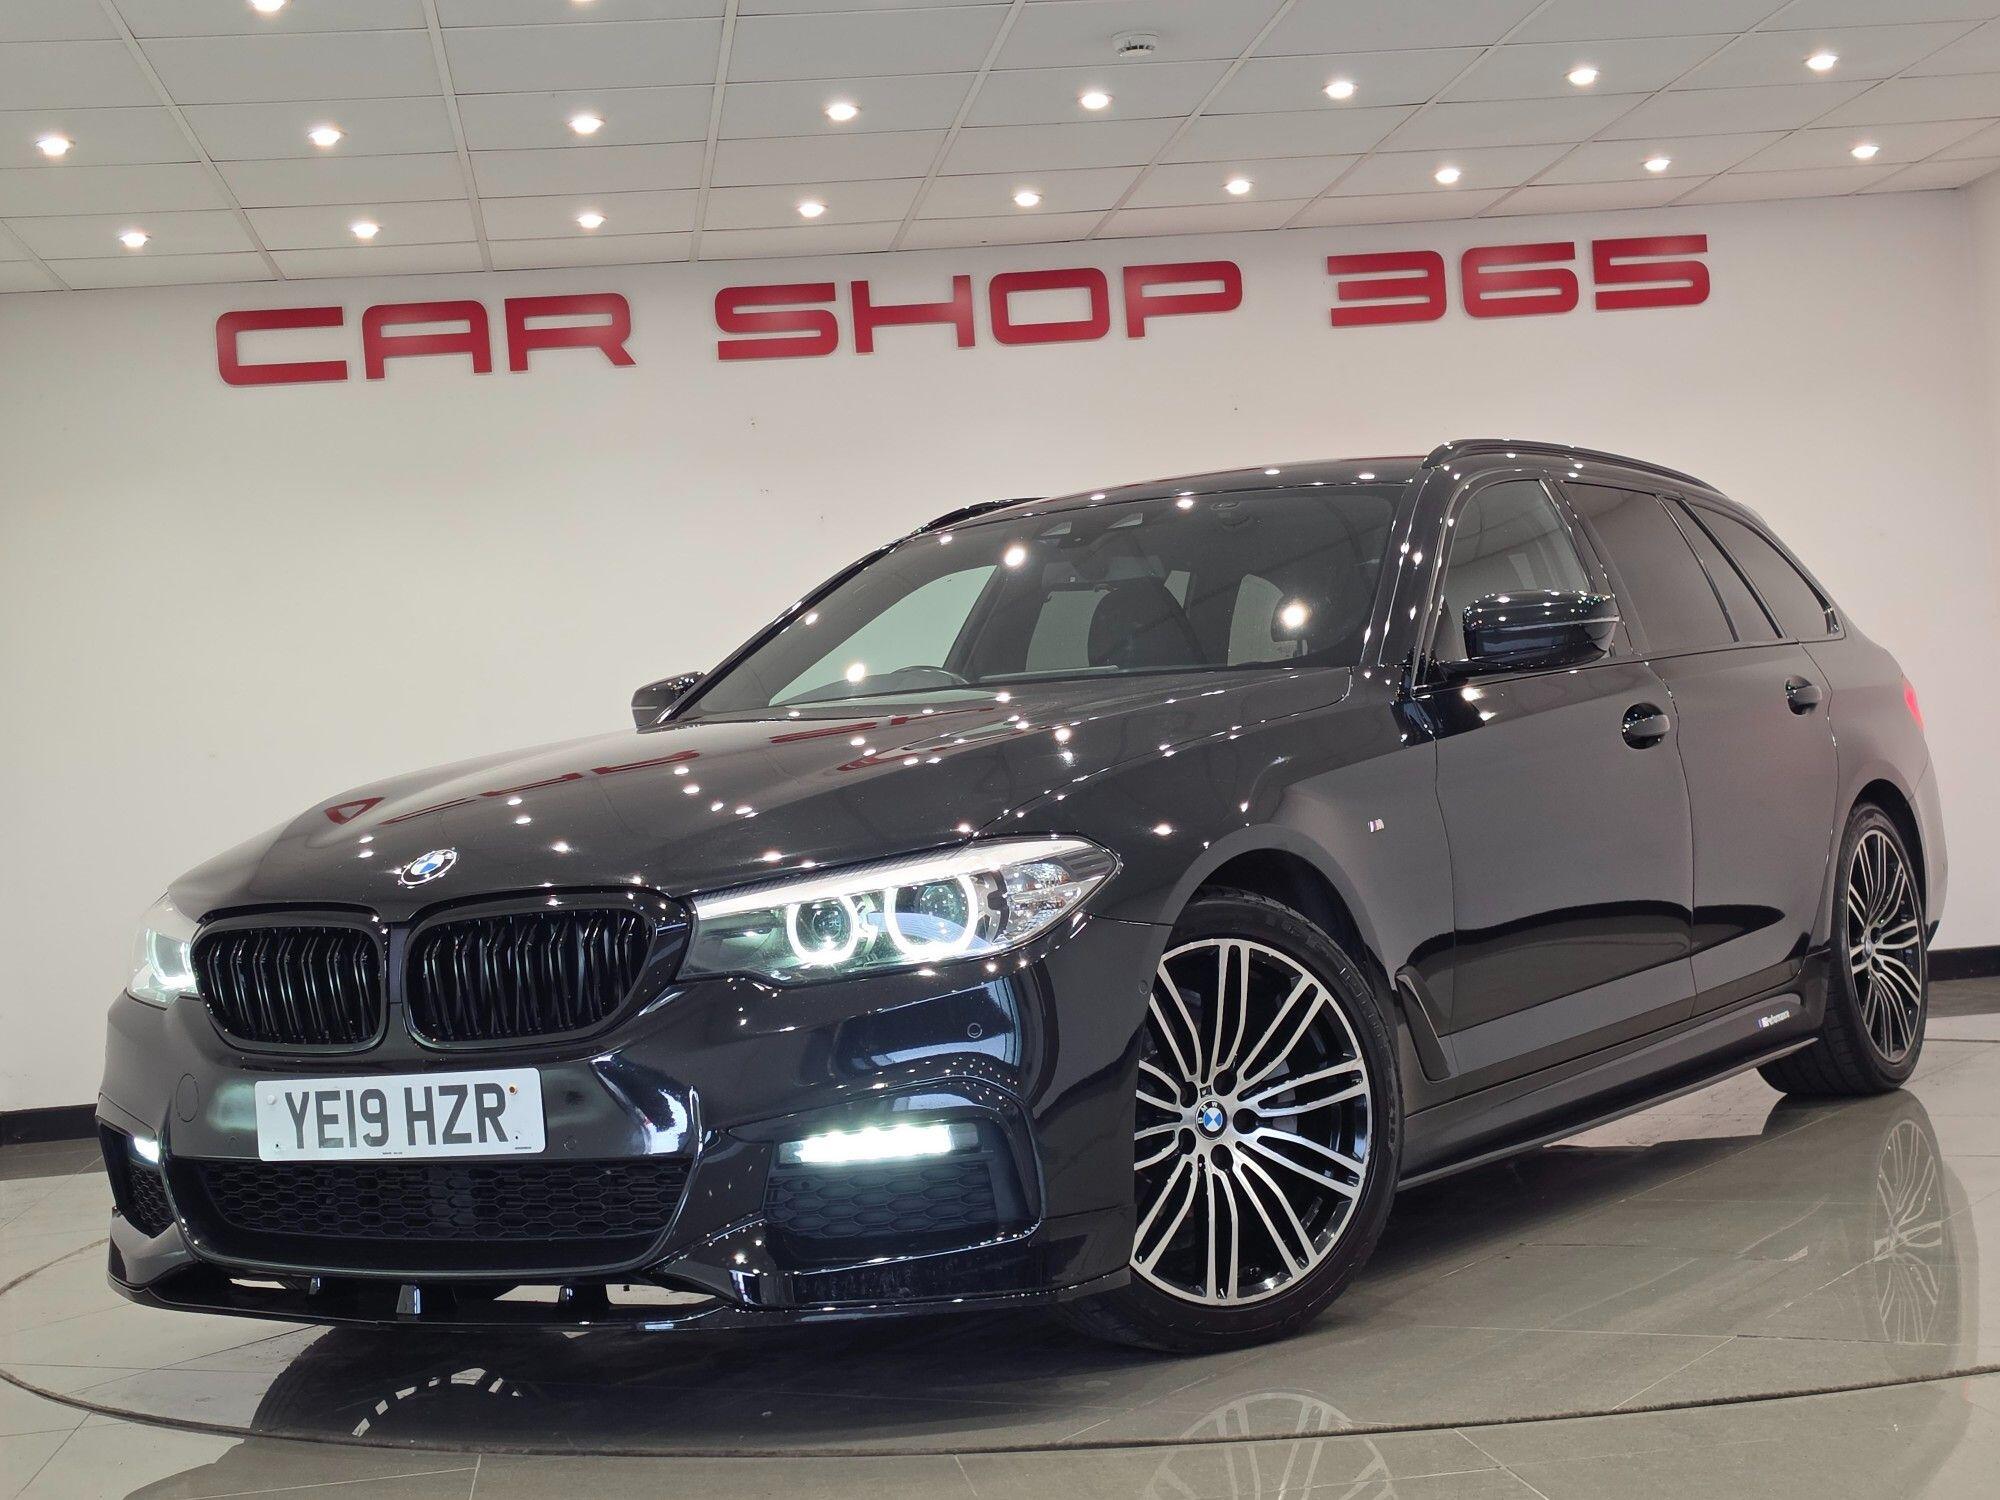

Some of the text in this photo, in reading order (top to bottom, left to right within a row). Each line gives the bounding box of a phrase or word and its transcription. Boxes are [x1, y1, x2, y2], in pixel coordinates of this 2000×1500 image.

[217, 234, 1711, 386] CAR SHOP 365
[285, 1082, 509, 1149] YE19 HZR
[1197, 1101, 1219, 1125] BMW
